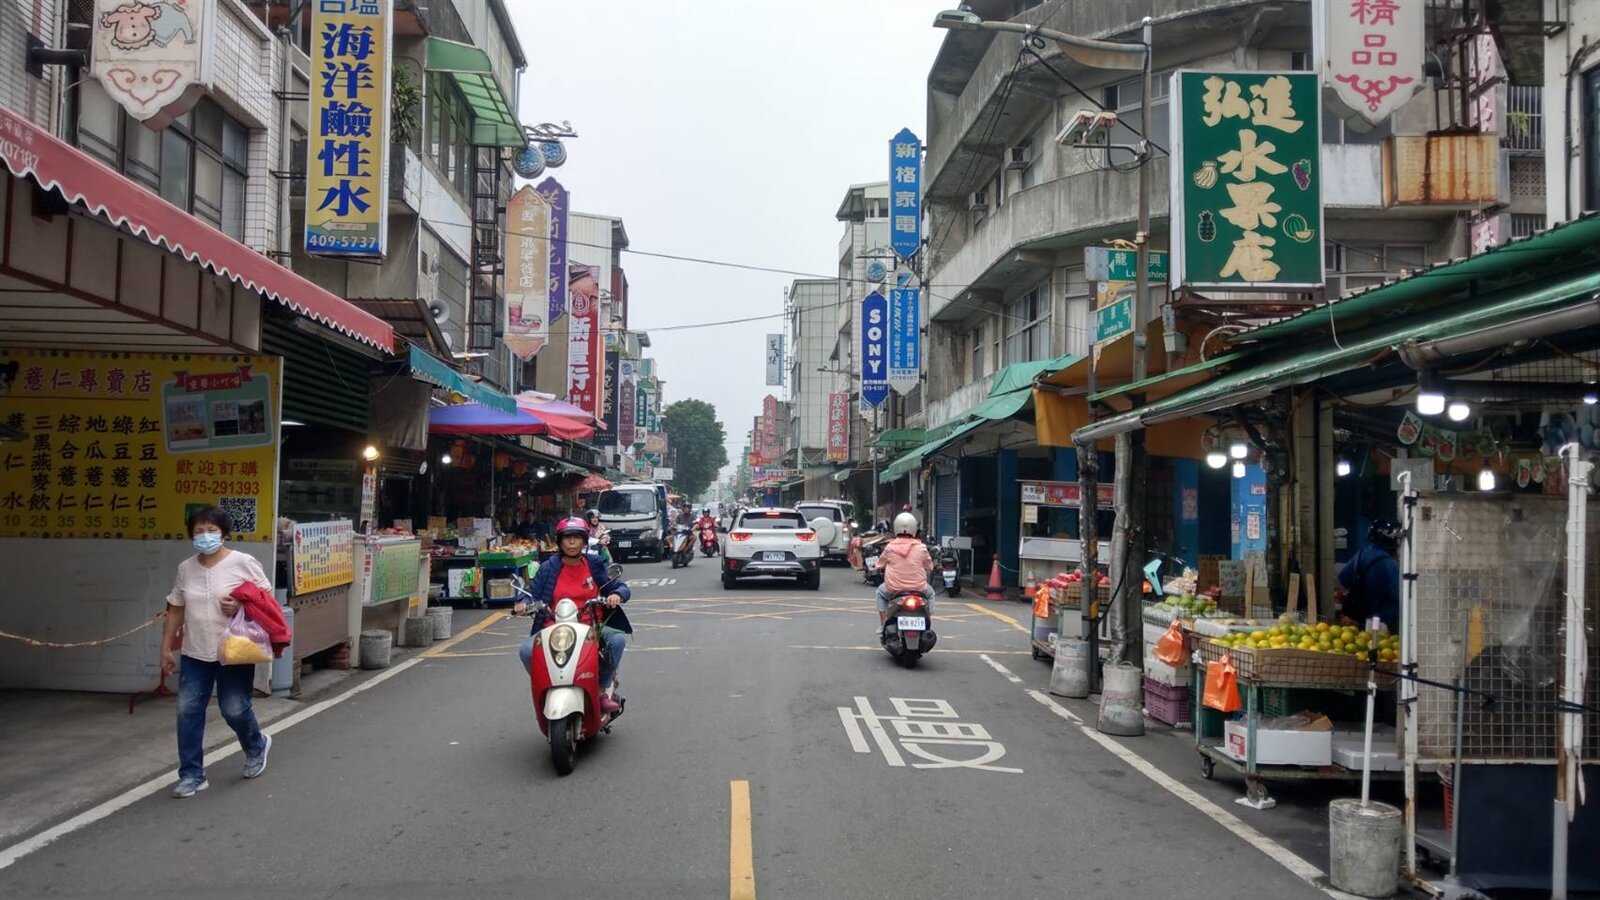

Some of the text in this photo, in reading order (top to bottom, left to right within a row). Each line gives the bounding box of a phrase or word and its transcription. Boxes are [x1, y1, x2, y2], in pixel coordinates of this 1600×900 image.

[317, 22, 376, 217] 海洋鹼性水
[895, 142, 916, 233] 新格家電
[1217, 129, 1288, 282] 水果店
[309, 234, 376, 249] 409-5737
[868, 309, 882, 374] SONY
[24, 367, 152, 394] 薏仁專賣店
[29, 416, 53, 510] 三黑燕麥飲
[56, 414, 81, 511] 綜合薏仁
[83, 416, 108, 511] 地瓜薏仁
[110, 416, 133, 511] 綠豆薏仁
[136, 417, 160, 513] 紅豆薏仁
[176, 459, 258, 477] 歡迎訂購
[175, 480, 260, 495] 0975-291393
[4, 515, 20, 527] 10
[30, 515, 48, 527] 25
[57, 515, 75, 528] 35
[84, 515, 102, 528] 35
[112, 516, 129, 528] 35
[139, 517, 156, 529] 35
[837, 696, 1024, 773] 慢
